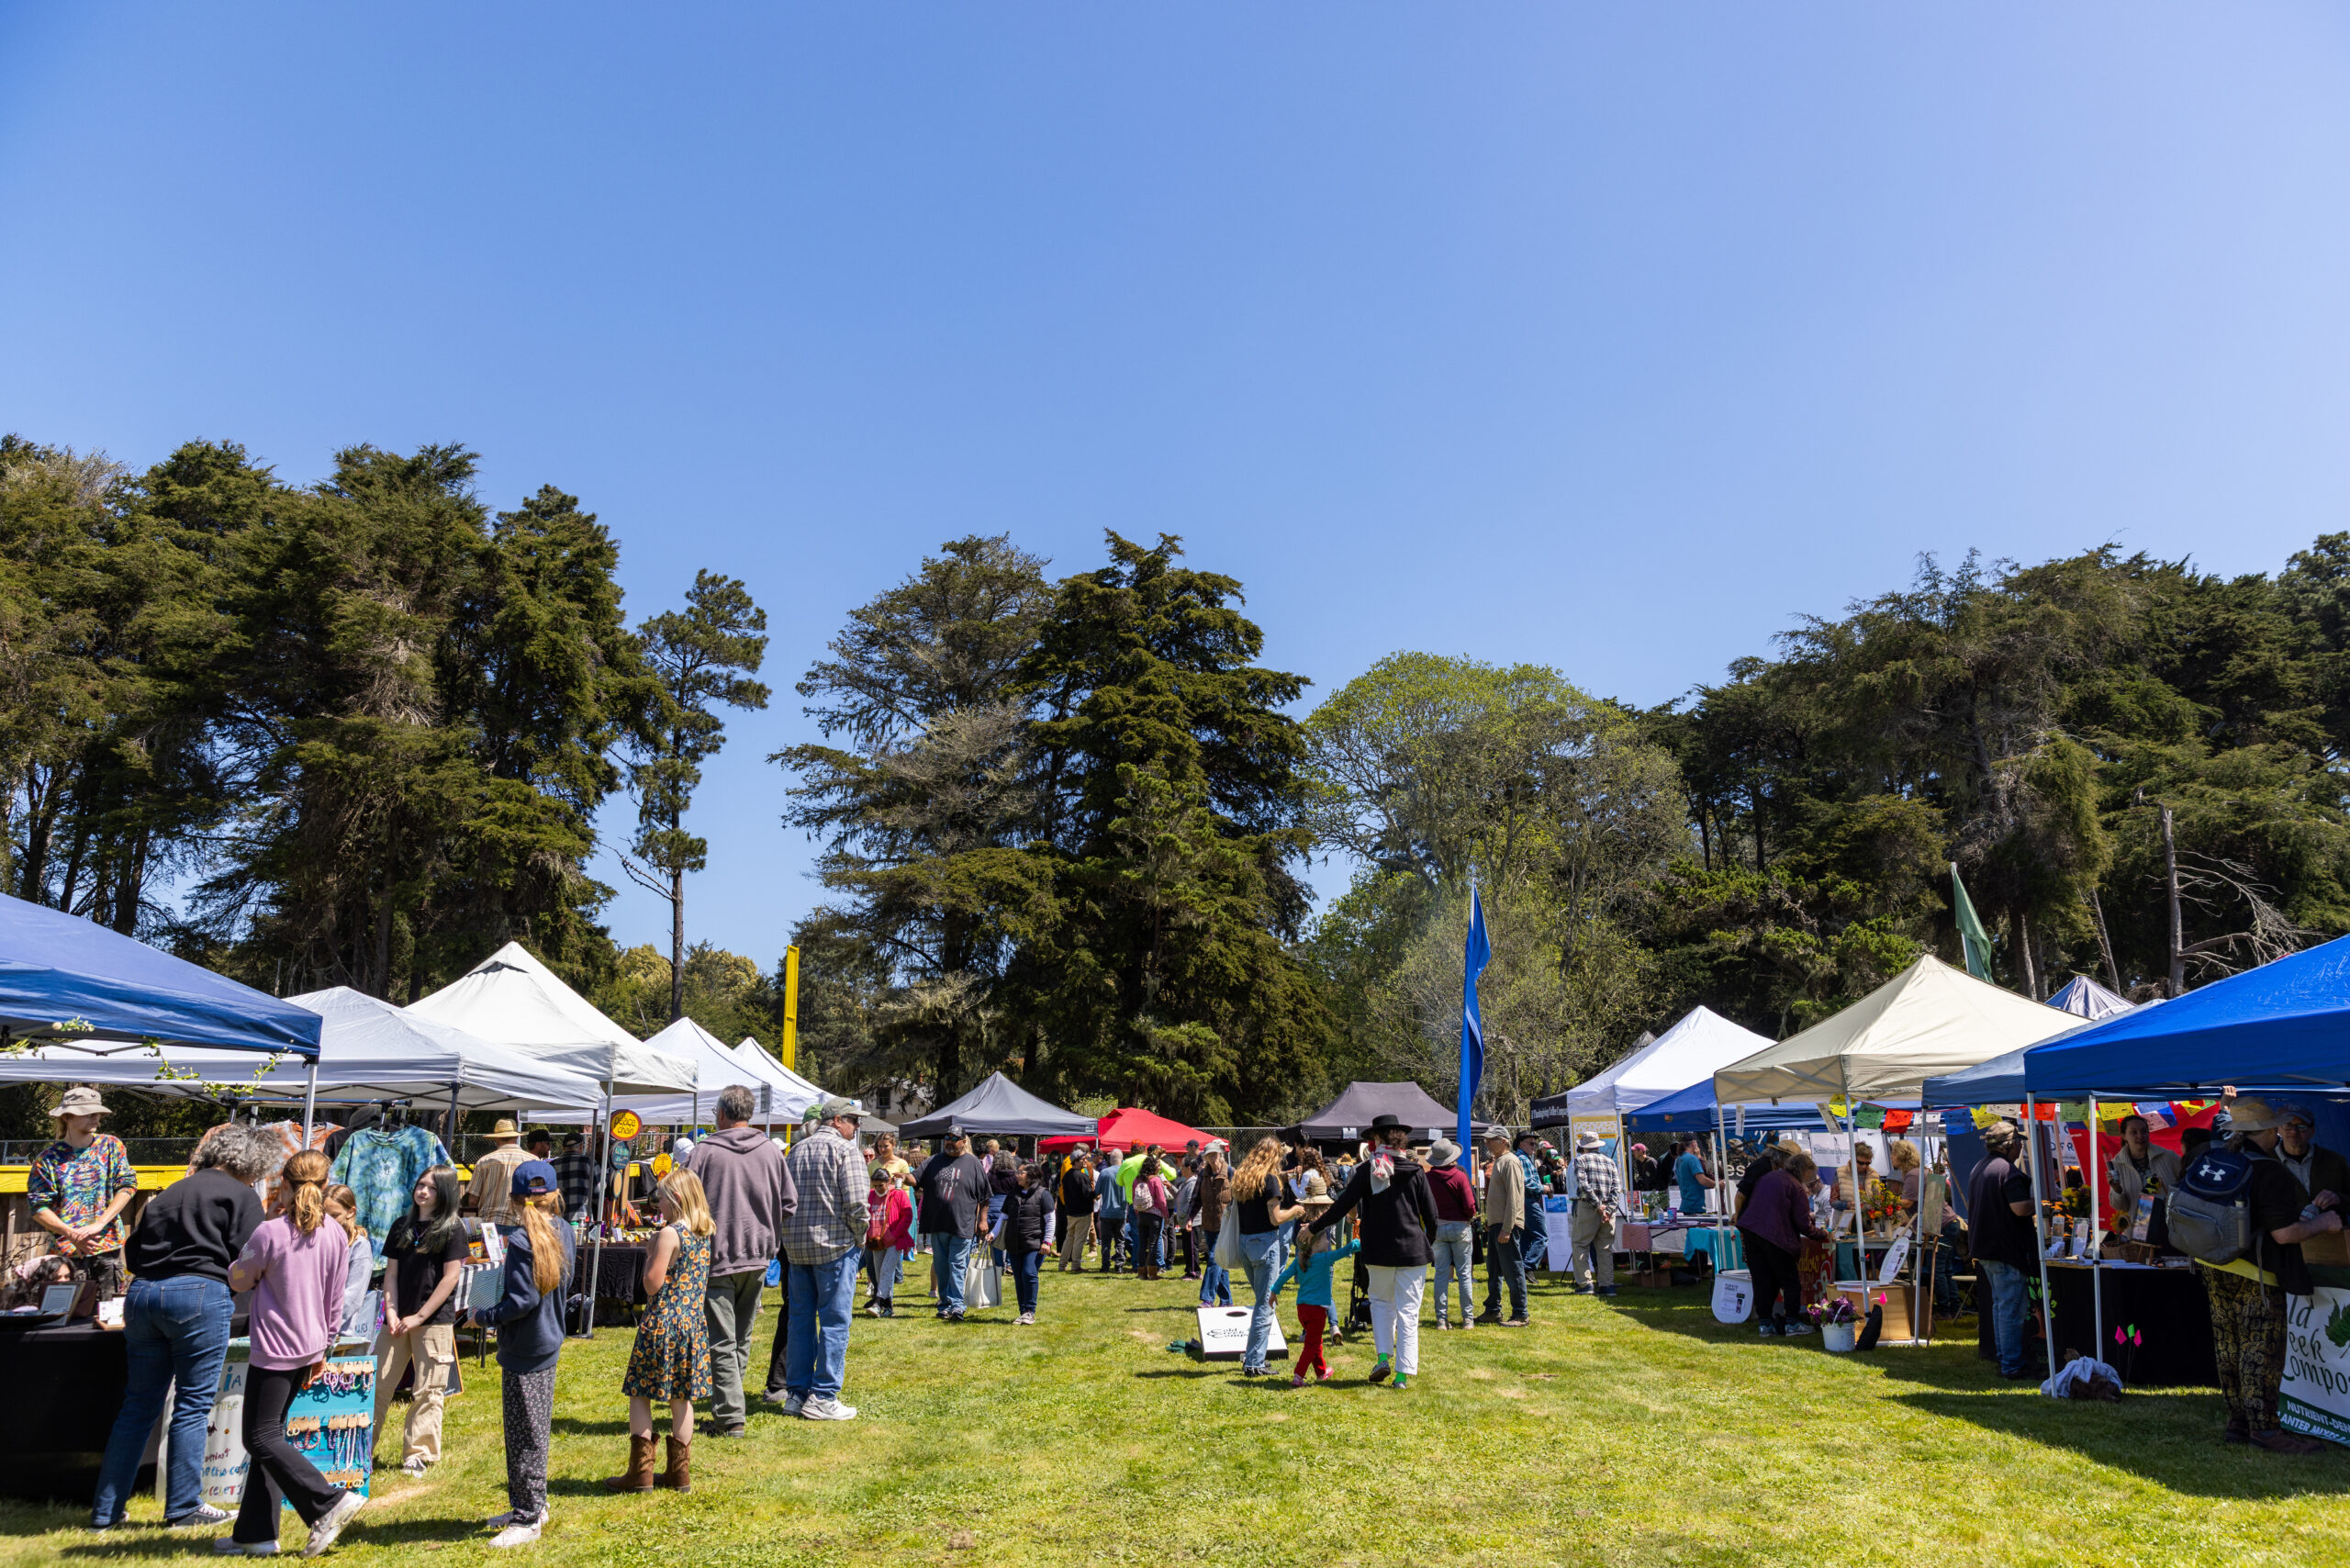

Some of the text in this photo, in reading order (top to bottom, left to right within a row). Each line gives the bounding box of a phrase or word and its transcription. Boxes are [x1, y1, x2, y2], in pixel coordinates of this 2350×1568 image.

[614, 1116, 636, 1128] peace
[2288, 1295, 2314, 1328] ld
[2288, 1328, 2326, 1363] eek
[2282, 1356, 2350, 1395] ompo
[2287, 1400, 2350, 1434] NUTRIENT-DEN
